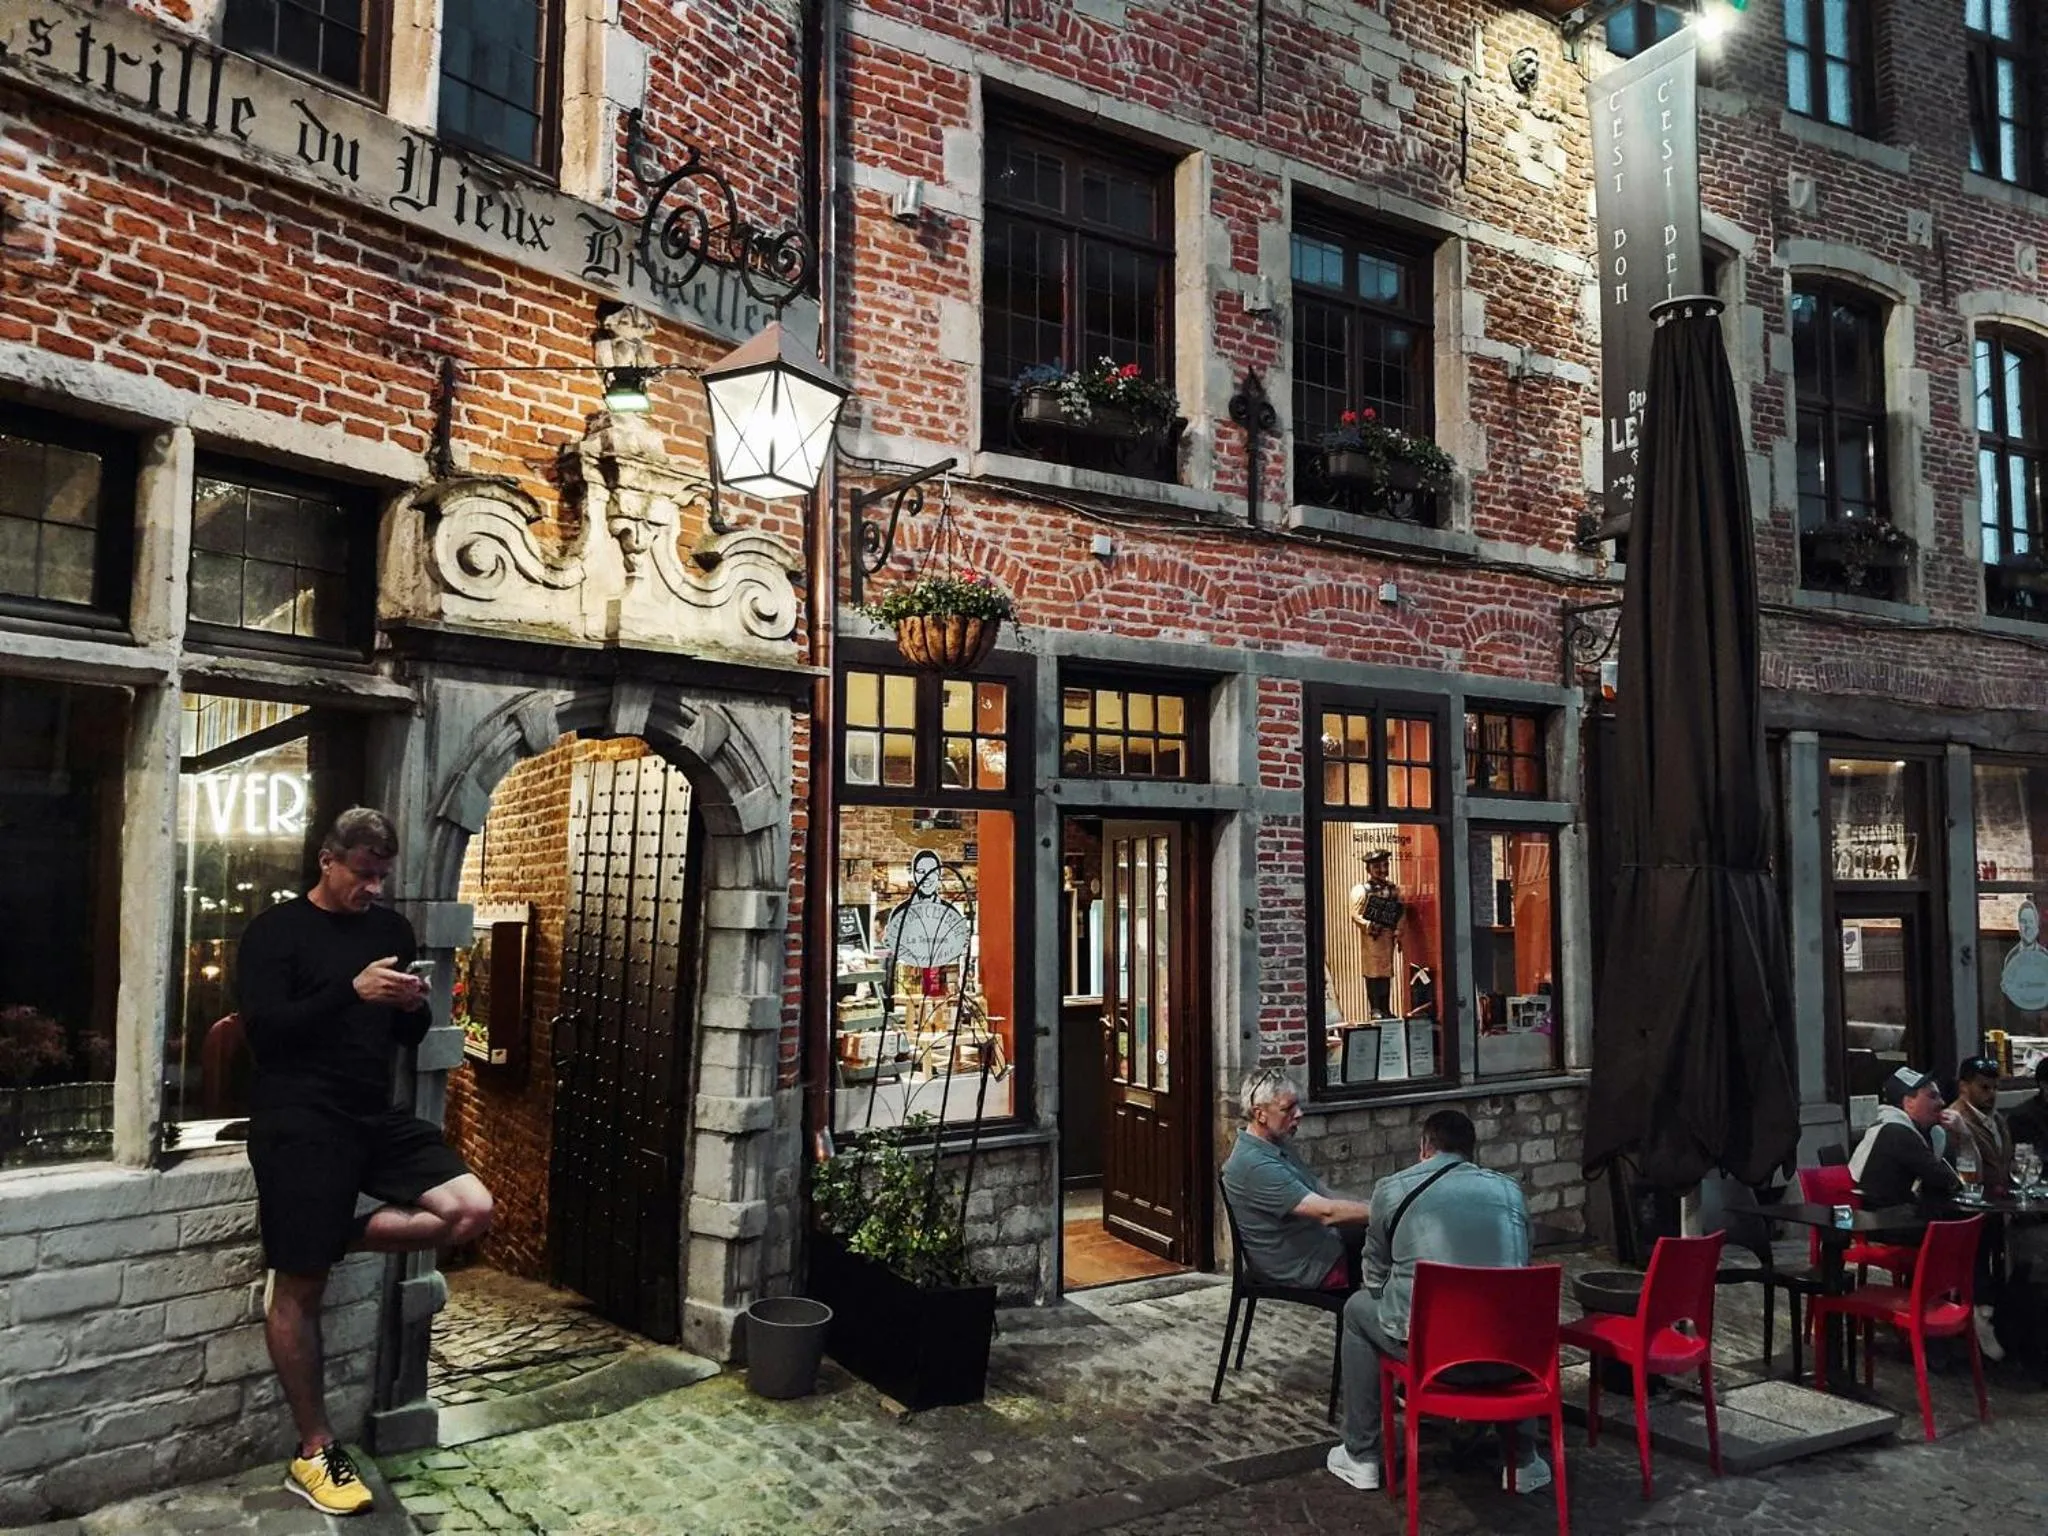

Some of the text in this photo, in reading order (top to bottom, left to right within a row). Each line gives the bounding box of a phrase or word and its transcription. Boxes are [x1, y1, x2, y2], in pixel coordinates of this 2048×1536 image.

[0, 17, 256, 142] strille
[291, 97, 361, 182] du
[389, 135, 555, 252] Vieux
[1243, 907, 1255, 930] 5
